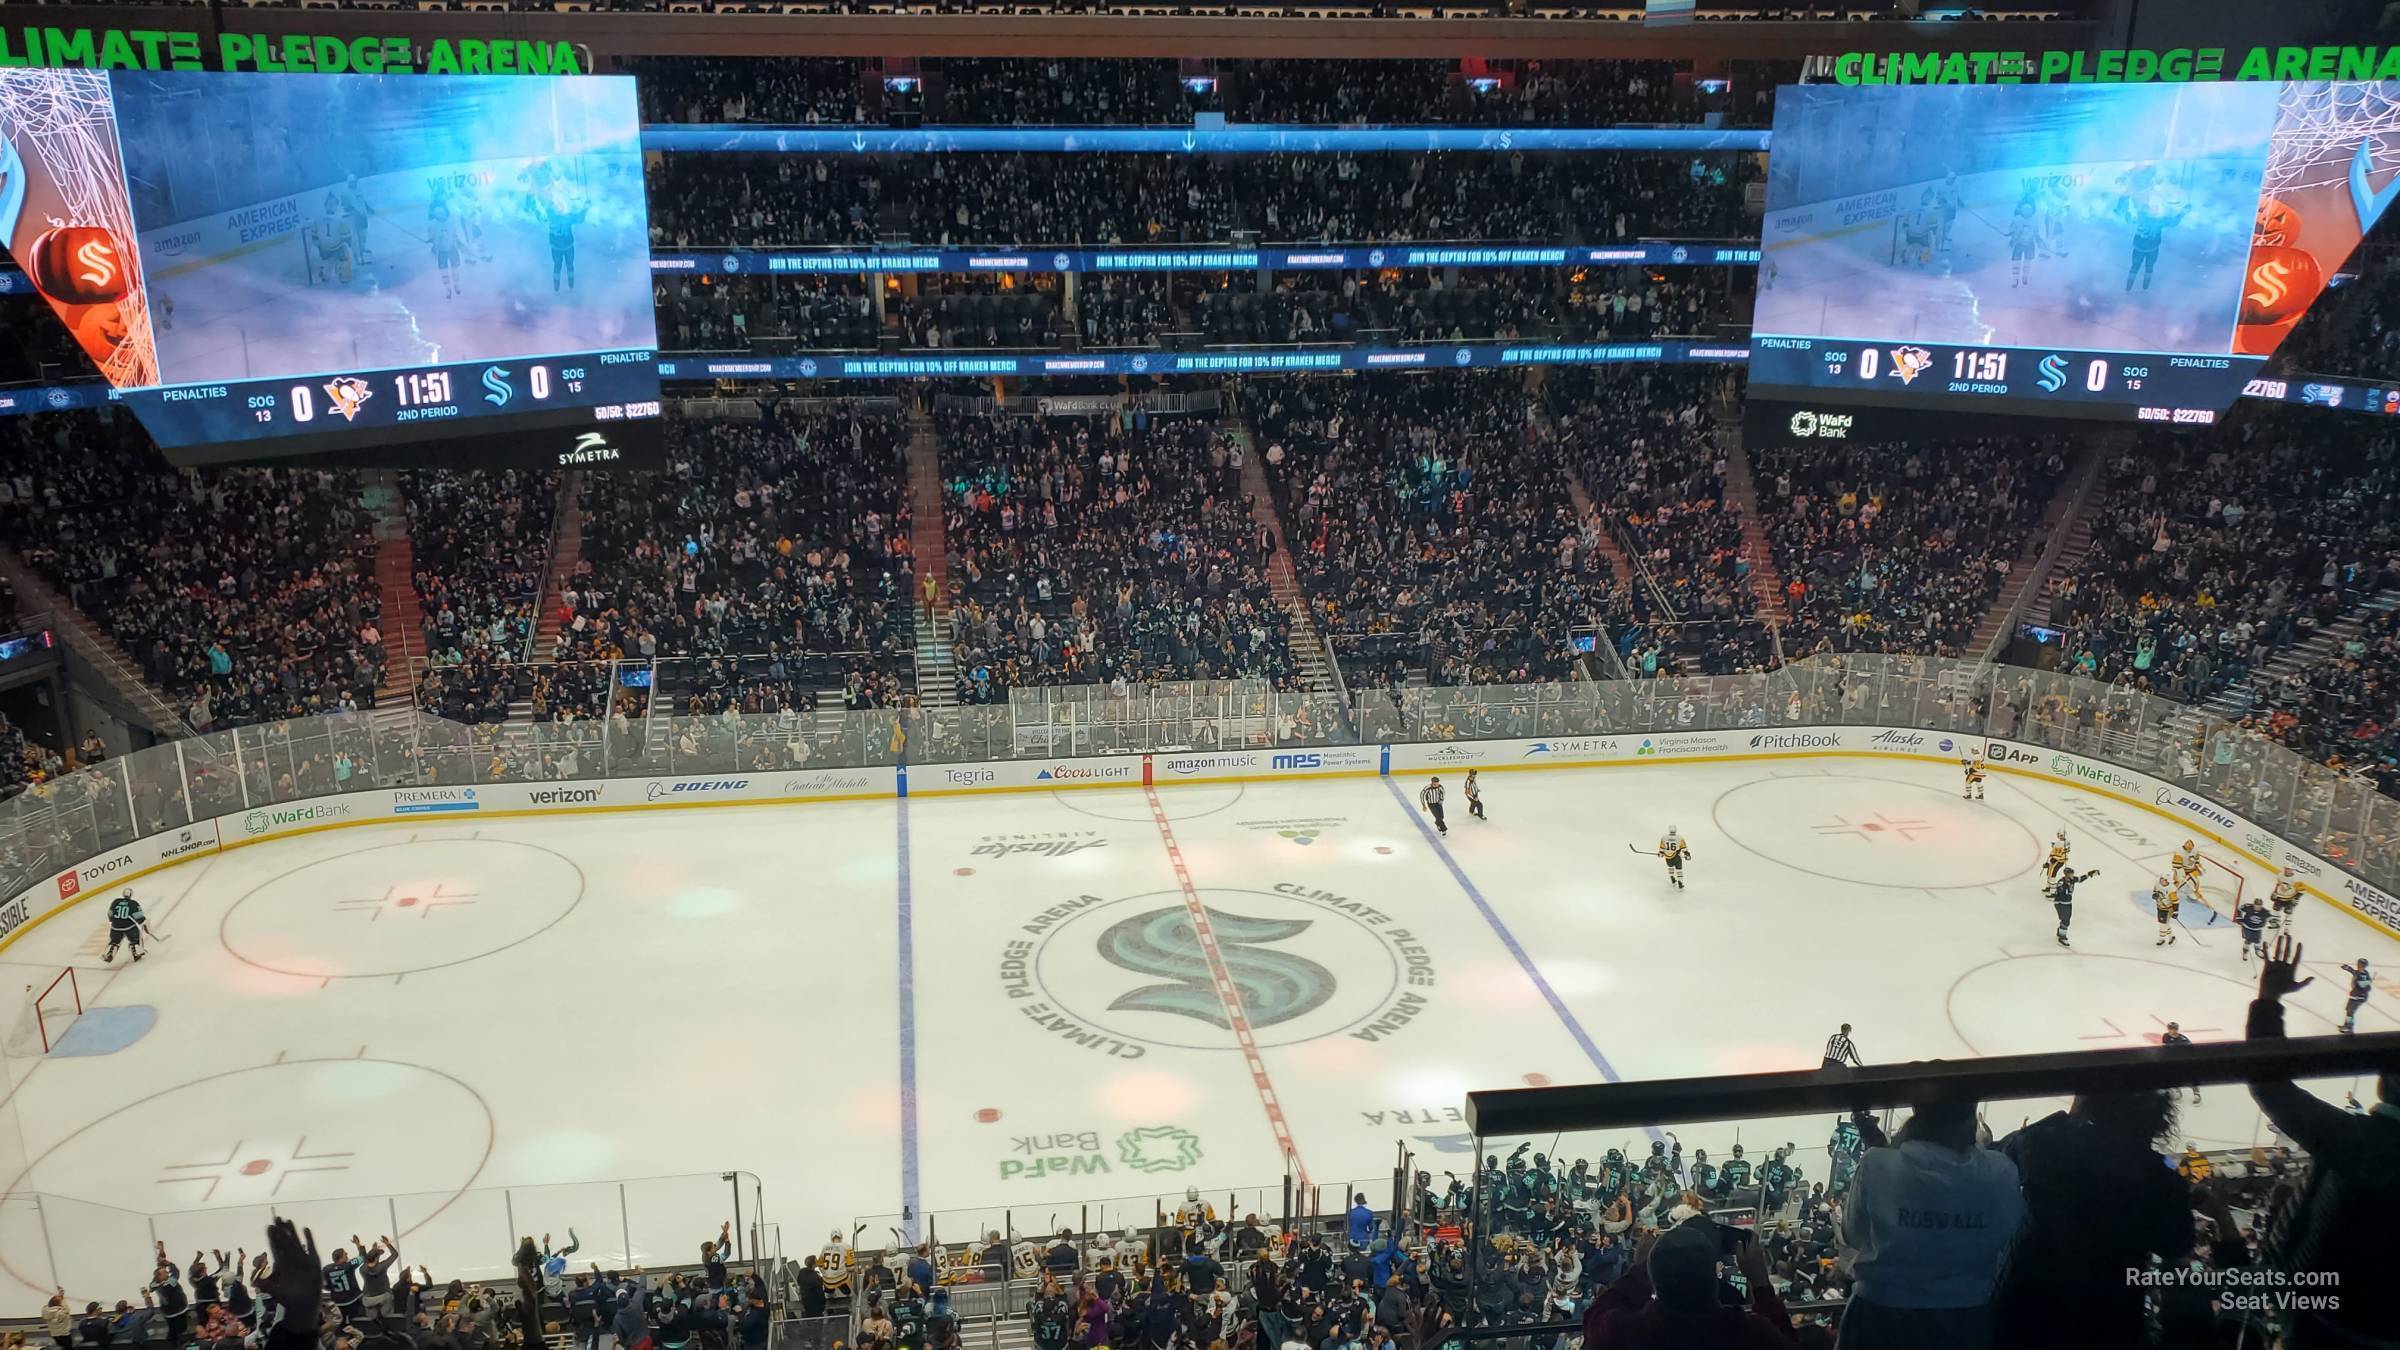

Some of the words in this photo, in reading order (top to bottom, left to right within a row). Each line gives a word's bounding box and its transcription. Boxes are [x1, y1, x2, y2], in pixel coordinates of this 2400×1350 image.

[218, 32, 412, 74] PLEDGE
[427, 38, 581, 75] ARENA
[1835, 51, 2025, 85] CLIMATE
[2039, 48, 2225, 84] PLEDGE
[2235, 46, 2400, 82] ARENA
[428, 171, 490, 192] verizon
[2022, 173, 2085, 192] verizon
[1836, 191, 1899, 214] AMERICAN
[228, 200, 297, 231] AMERICAN
[1775, 212, 1813, 229] amazon
[1843, 206, 1898, 226] EXPRESS
[240, 215, 300, 243] EXPRESS
[154, 231, 201, 253] amazon
[1761, 338, 1811, 350] PENALTIES
[600, 351, 650, 365] PENALTIES
[1825, 352, 1847, 363] SOG
[1860, 348, 1879, 379] 0
[1953, 351, 2007, 380] 11:51
[2170, 357, 2230, 370] PENALTIES
[562, 368, 585, 381] SOG
[1828, 364, 1842, 375] 13
[2087, 359, 2108, 392] 0
[2123, 366, 2148, 378] SOG
[394, 371, 451, 406] 11:51
[529, 365, 549, 399] 0
[568, 382, 582, 394] 15
[1948, 382, 1969, 392] 2ND
[1971, 384, 2008, 395] PERIOD
[2126, 380, 2141, 391] 15
[163, 387, 228, 402] PENALTIES
[248, 395, 275, 409] SOG
[291, 385, 313, 422] 0
[594, 405, 623, 420] 50/50:
[626, 402, 660, 419] $22760
[255, 410, 272, 423] 13
[397, 409, 418, 421] 2ND
[420, 405, 458, 420] PERIOD
[1819, 413, 1853, 427] WaFd
[2138, 407, 2170, 422] 50/50:
[2173, 410, 2214, 425] $22760
[1819, 426, 1847, 438] Bank
[559, 448, 620, 465] SYMETRA
[1553, 741, 1618, 752] SYMETRA
[1659, 737, 1689, 746] Virginia
[1691, 736, 1717, 745] Mason
[1764, 732, 1841, 748] PitchBook
[1871, 730, 1924, 746] Alaska
[1658, 744, 1701, 754] Franciscan
[1702, 744, 1729, 752] Health
[1167, 759, 1216, 771] amazon
[1218, 755, 1256, 767] music
[1272, 754, 1320, 769] MPS
[945, 767, 994, 786] Tegria
[1053, 765, 1092, 779] Coors
[1094, 767, 1129, 778] LIGHT
[2076, 764, 2112, 784] WaFd
[2113, 773, 2143, 794] Bank
[671, 780, 749, 793] BOEING
[394, 790, 456, 803] PREMERA
[529, 786, 597, 805] verizon
[272, 807, 315, 825] WaFd
[315, 803, 351, 818] Bank
[2177, 797, 2235, 829] BOEING
[1666, 842, 1677, 851] 16
[82, 855, 133, 882] TOYOTA
[2285, 852, 2322, 877] amazon
[1273, 882, 1392, 925] CLIMATE
[114, 906, 129, 919] 30
[1021, 894, 1104, 935] ARENA
[1384, 928, 1434, 986] PLEDGE
[1000, 940, 1035, 999] PLEDGE
[1349, 992, 1428, 1042] ARENA
[1020, 1003, 1146, 1060] CLIMATE
[1011, 1131, 1100, 1152] Bank
[1001, 1155, 1112, 1180] WaFd
[823, 1253, 840, 1270] 59
[1015, 1252, 1031, 1268] 15
[330, 1275, 350, 1293] 51
[1041, 1325, 1061, 1340] 37
